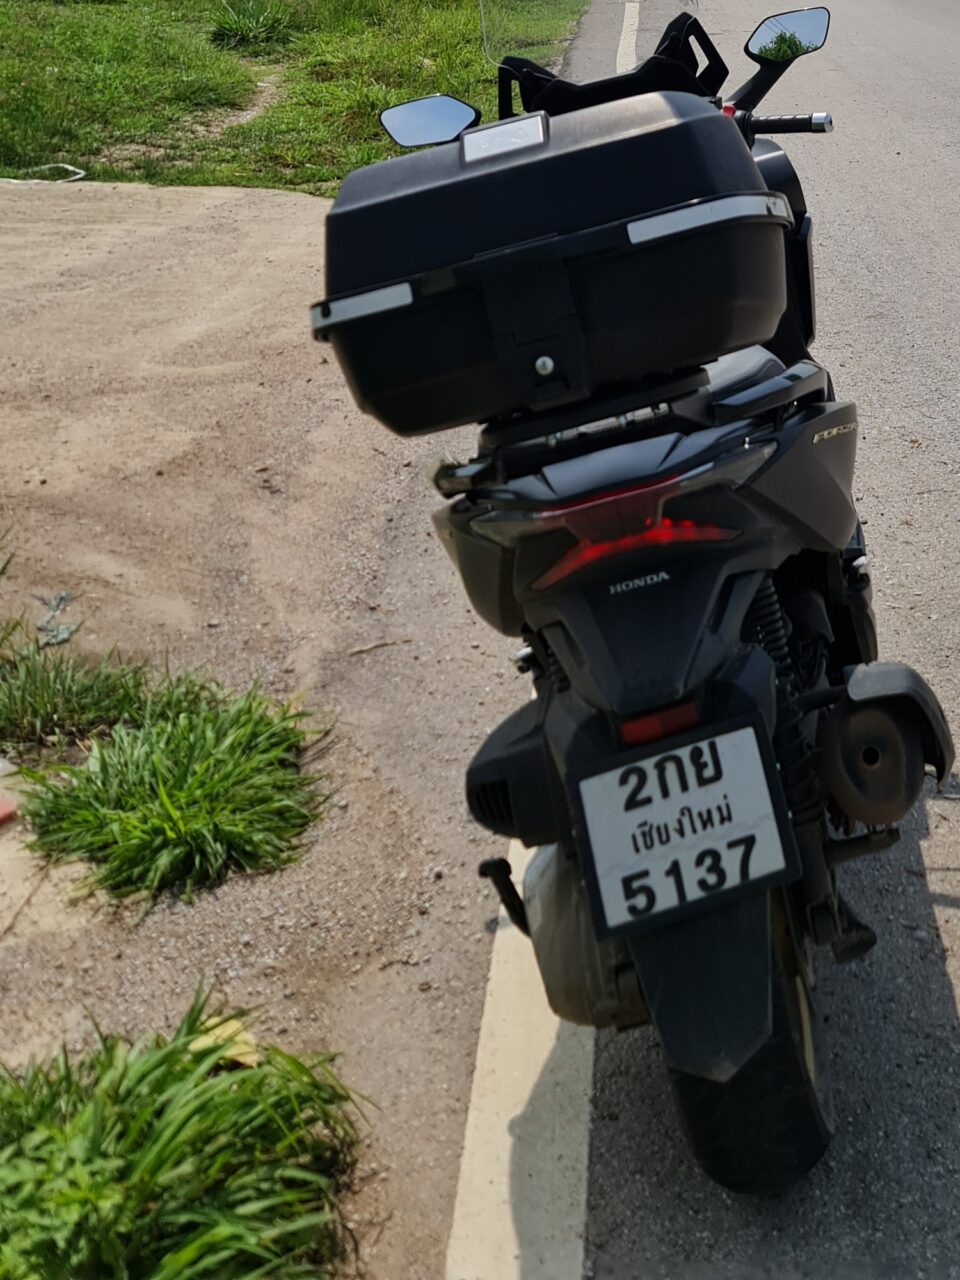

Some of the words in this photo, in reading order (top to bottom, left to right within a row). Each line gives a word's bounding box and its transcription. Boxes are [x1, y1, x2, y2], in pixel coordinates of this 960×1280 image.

[609, 571, 670, 594] HONDA
[618, 739, 723, 812] 2กย
[631, 793, 733, 855] เชียงใหม่
[621, 834, 757, 918] 5137
